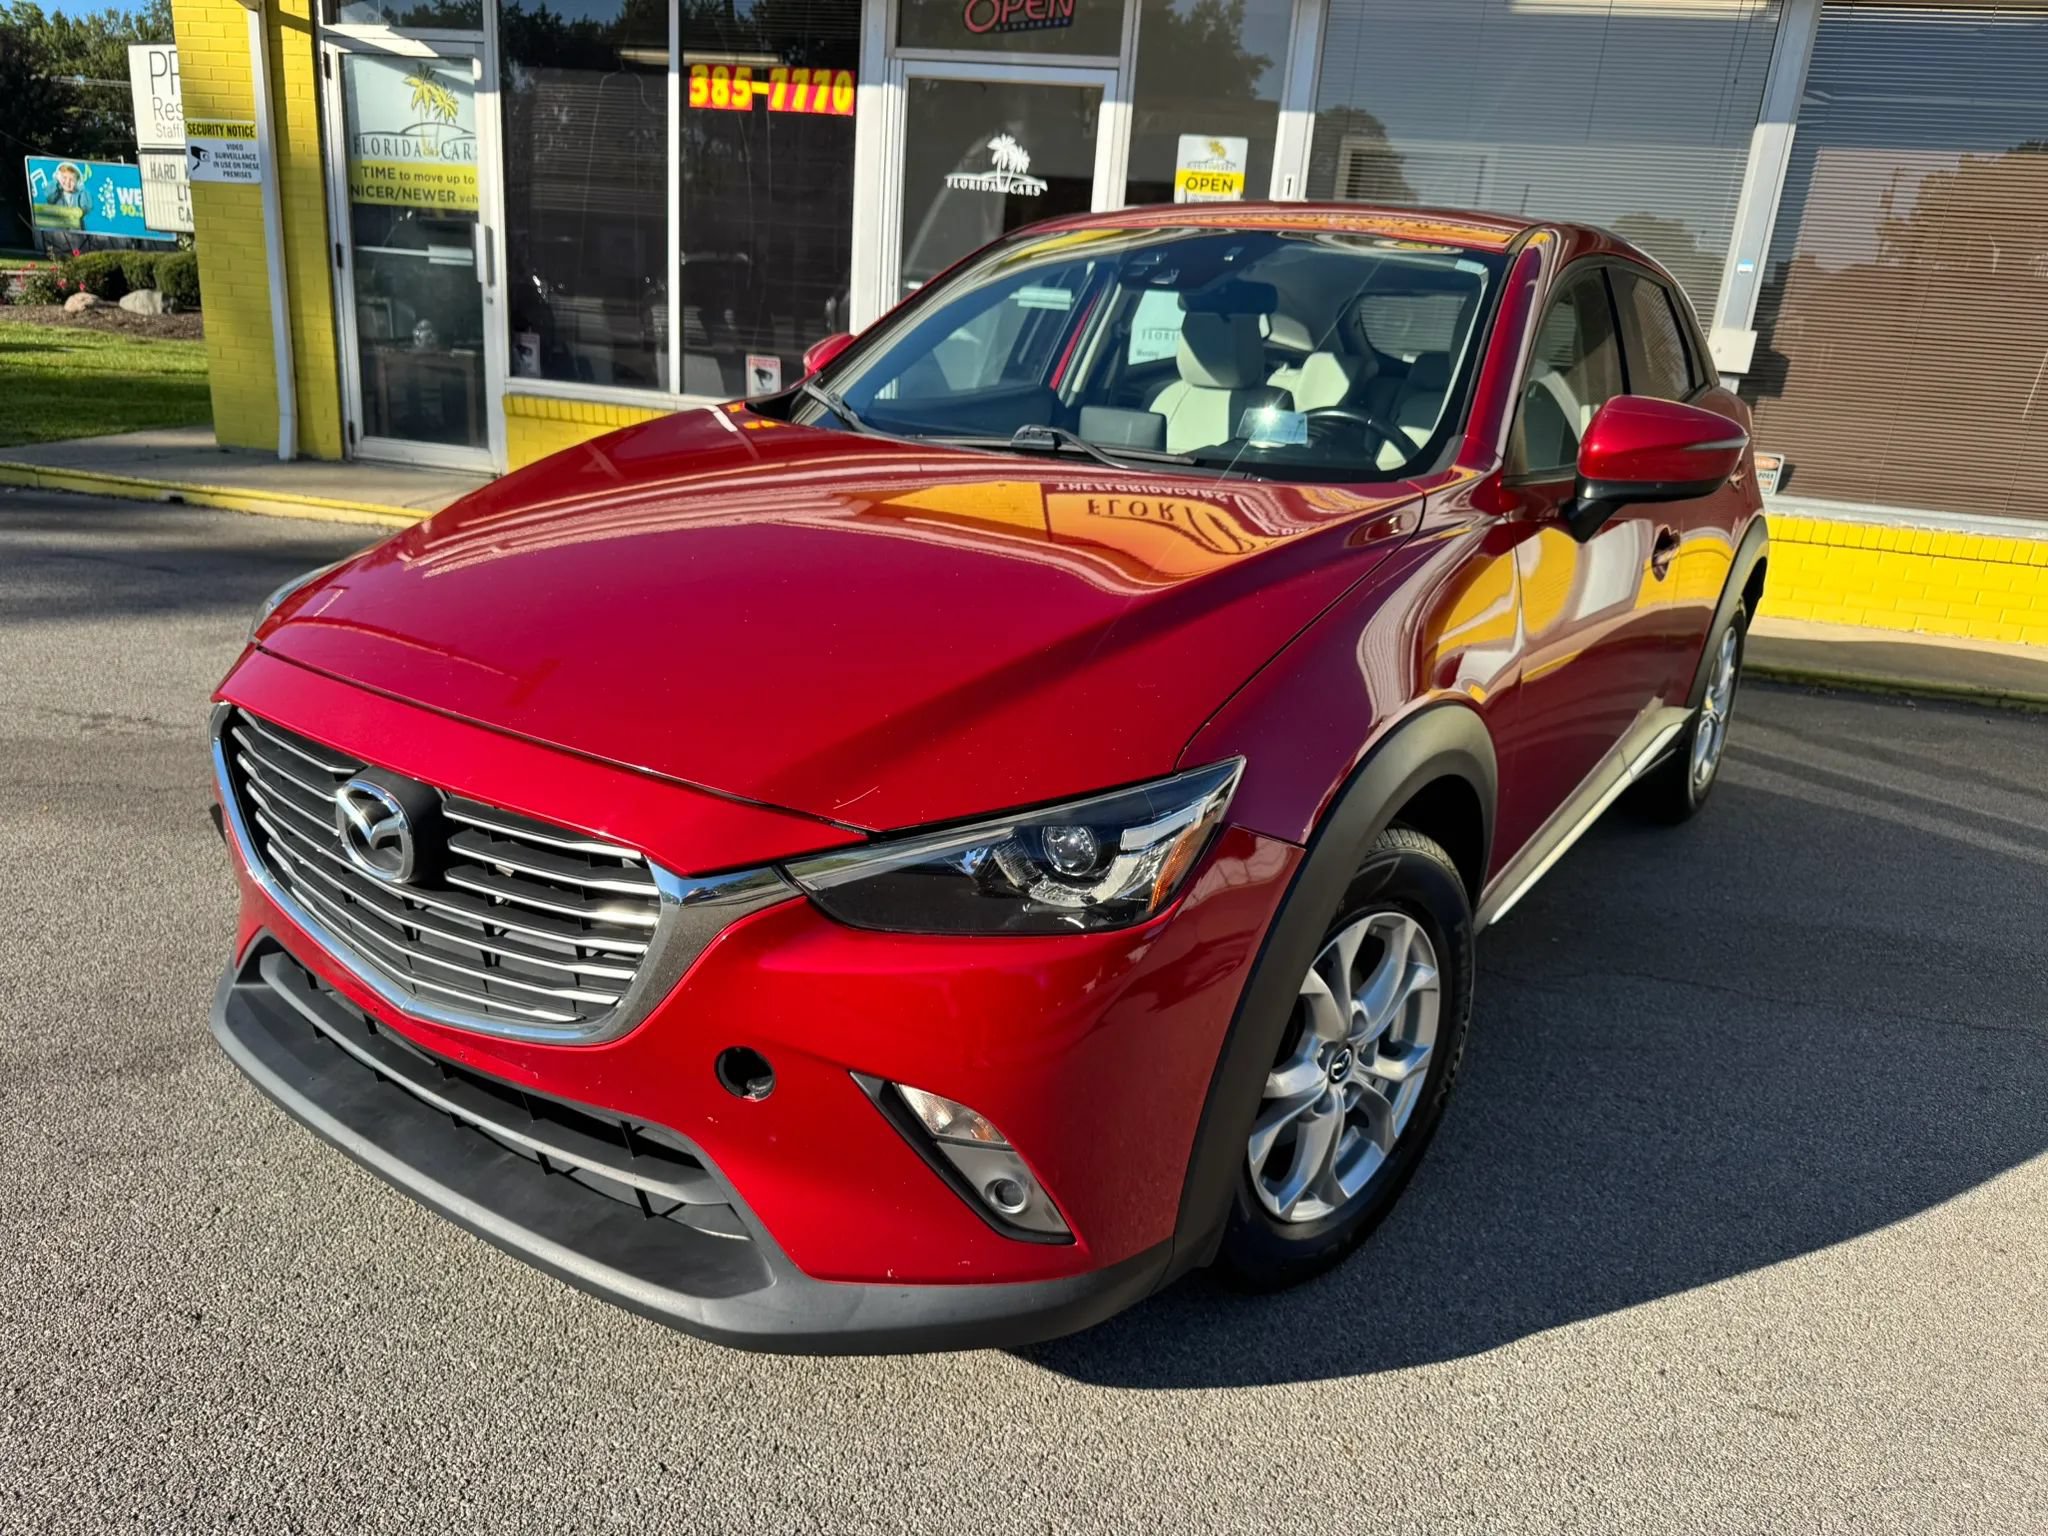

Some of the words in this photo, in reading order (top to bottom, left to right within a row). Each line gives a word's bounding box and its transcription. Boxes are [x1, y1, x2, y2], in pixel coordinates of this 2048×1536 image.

[689, 64, 853, 114] 385-7770
[187, 123, 224, 137] SECURITY
[226, 124, 255, 138] NOTICE
[226, 143, 243, 151] VIDEO
[353, 135, 422, 158] FLORIDA
[441, 141, 478, 161] CAR
[215, 152, 256, 161] SURVEILLANCE
[150, 162, 177, 180] HARD
[220, 161, 231, 169] USE
[242, 162, 259, 170] THESE
[223, 170, 252, 178] PREMISES
[361, 165, 396, 180] TIME
[399, 171, 411, 181] to
[414, 174, 443, 183] move
[446, 175, 460, 186] up
[464, 175, 475, 185] to
[350, 183, 456, 203] NICER/NEWER
[946, 177, 998, 192] FLORIDA
[1009, 183, 1041, 196] CARS
[1185, 176, 1234, 193] OPEN
